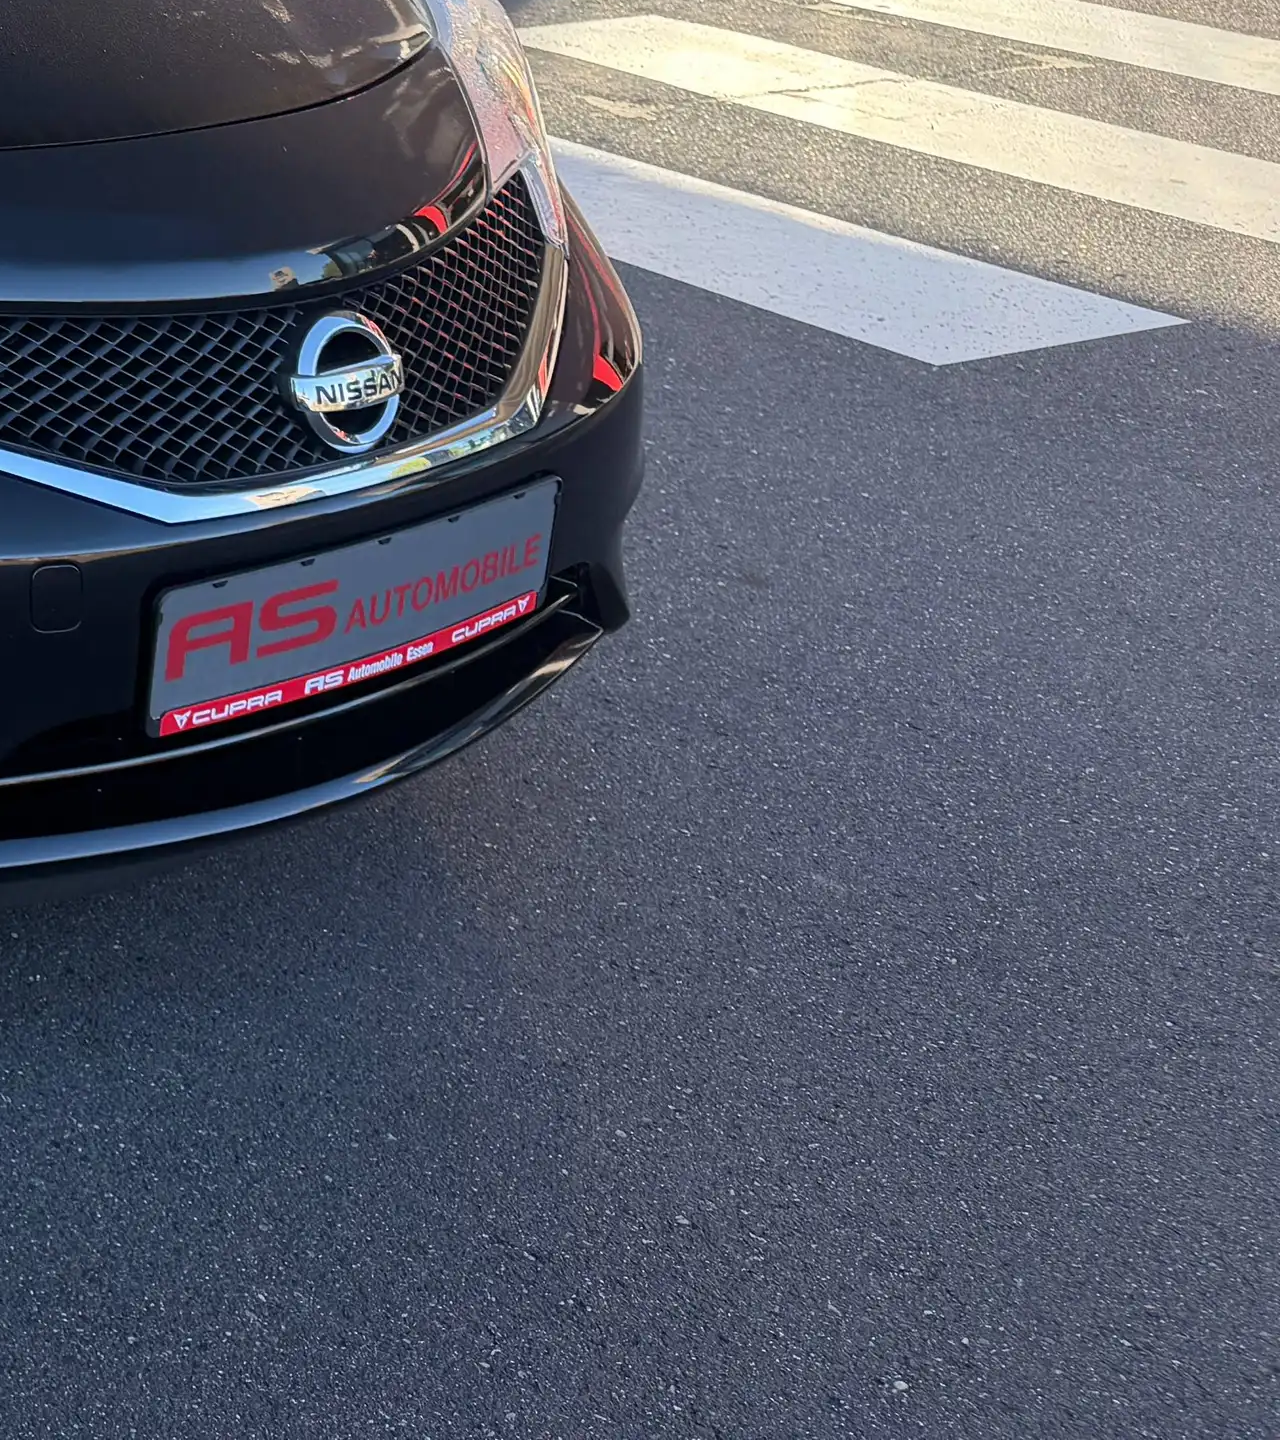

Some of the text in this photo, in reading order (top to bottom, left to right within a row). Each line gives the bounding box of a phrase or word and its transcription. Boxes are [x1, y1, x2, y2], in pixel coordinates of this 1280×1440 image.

[315, 369, 403, 405] NISSAN
[164, 532, 543, 683] AS AUTOMOBILE
[192, 605, 517, 726] CUPRA AS Automobile Essen CUPRA
